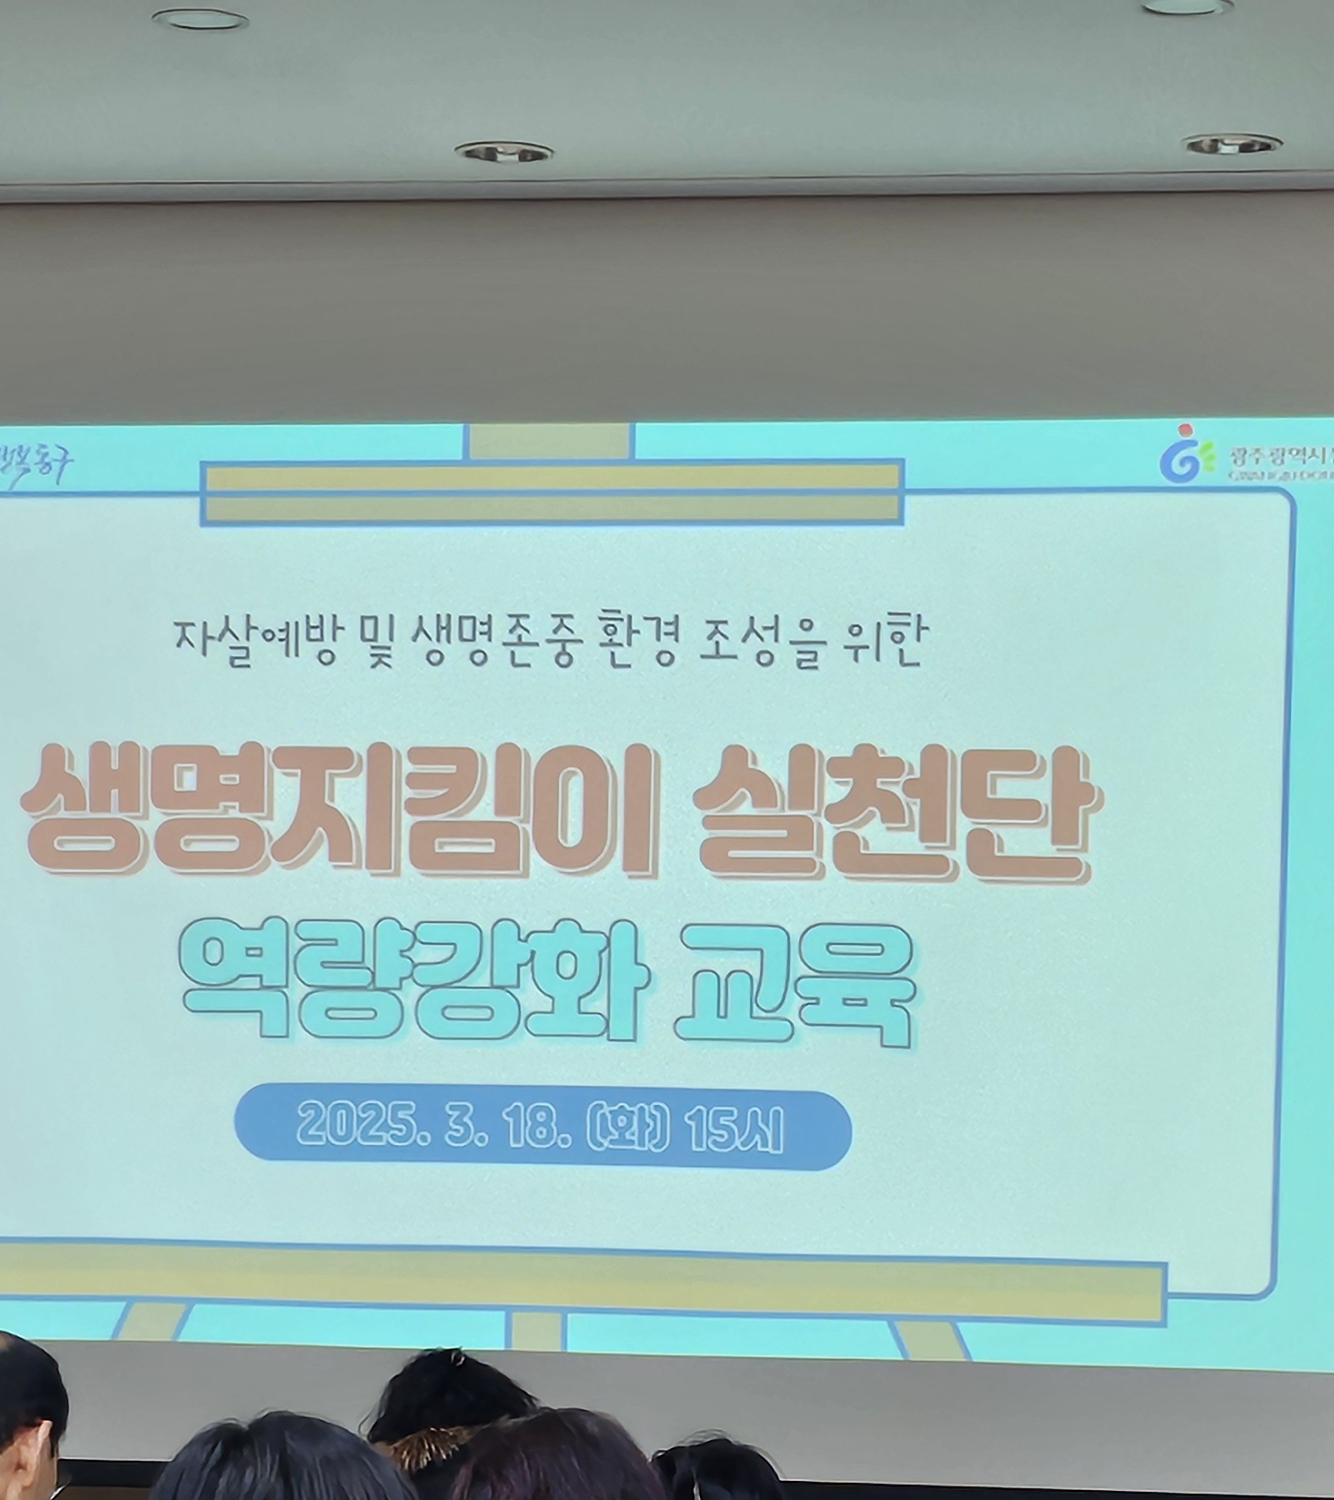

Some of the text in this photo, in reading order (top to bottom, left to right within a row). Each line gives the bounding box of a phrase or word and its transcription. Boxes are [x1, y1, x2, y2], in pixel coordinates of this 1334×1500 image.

[173, 609, 930, 671] 자살예방 및 생명존중 환경 조성을 위한
[20, 740, 1104, 886] 생명지킴이 실천단
[177, 916, 922, 1050] 역량강화 교육
[296, 1100, 784, 1154] 2025. 3. 18. (화) 15시
